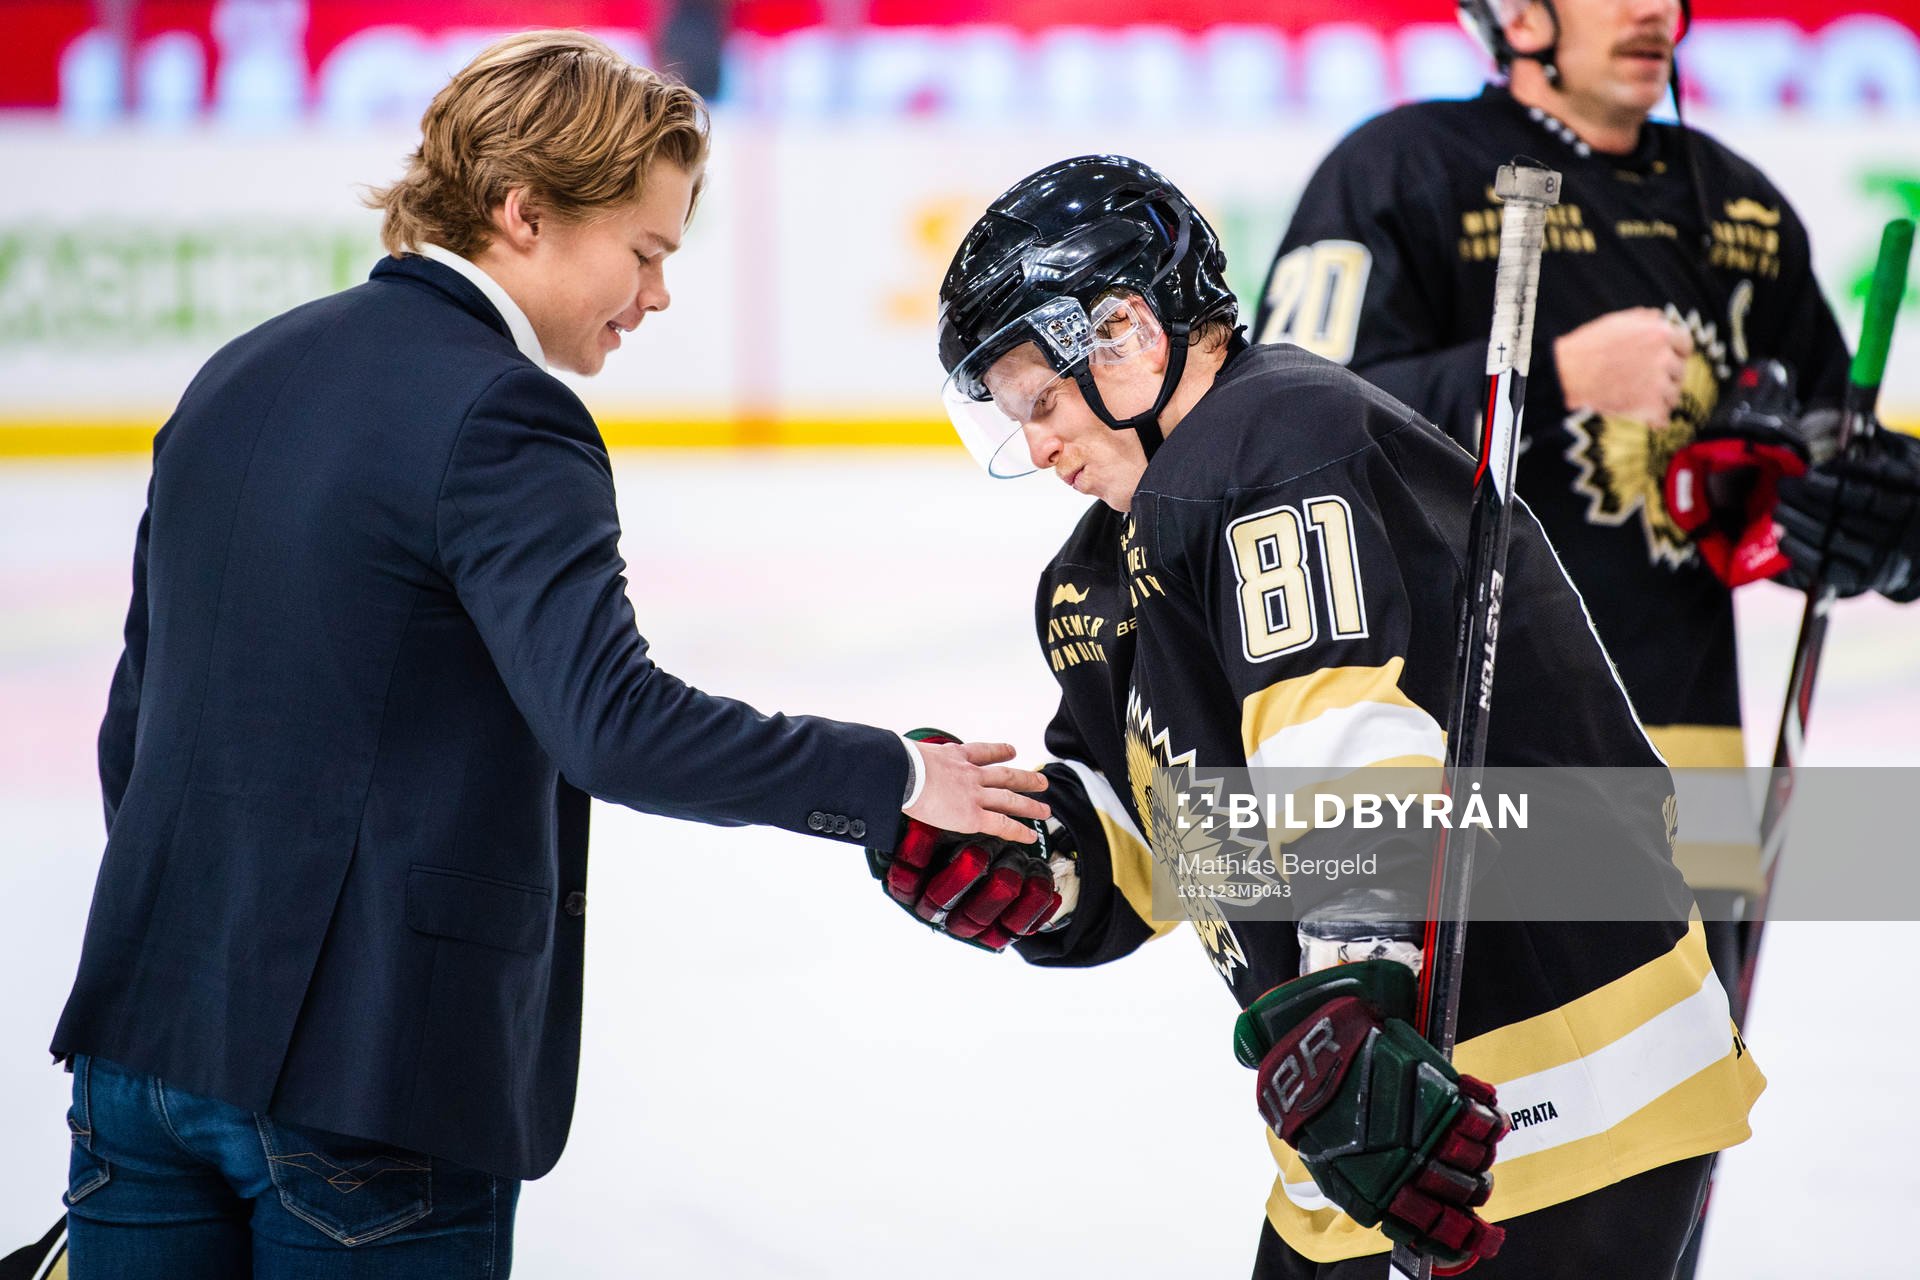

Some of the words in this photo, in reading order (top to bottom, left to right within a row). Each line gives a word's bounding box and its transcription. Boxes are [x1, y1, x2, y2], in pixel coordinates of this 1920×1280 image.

[1259, 239, 1373, 367] 20
[1226, 495, 1369, 663] 81
[1479, 569, 1503, 711] EASTON
